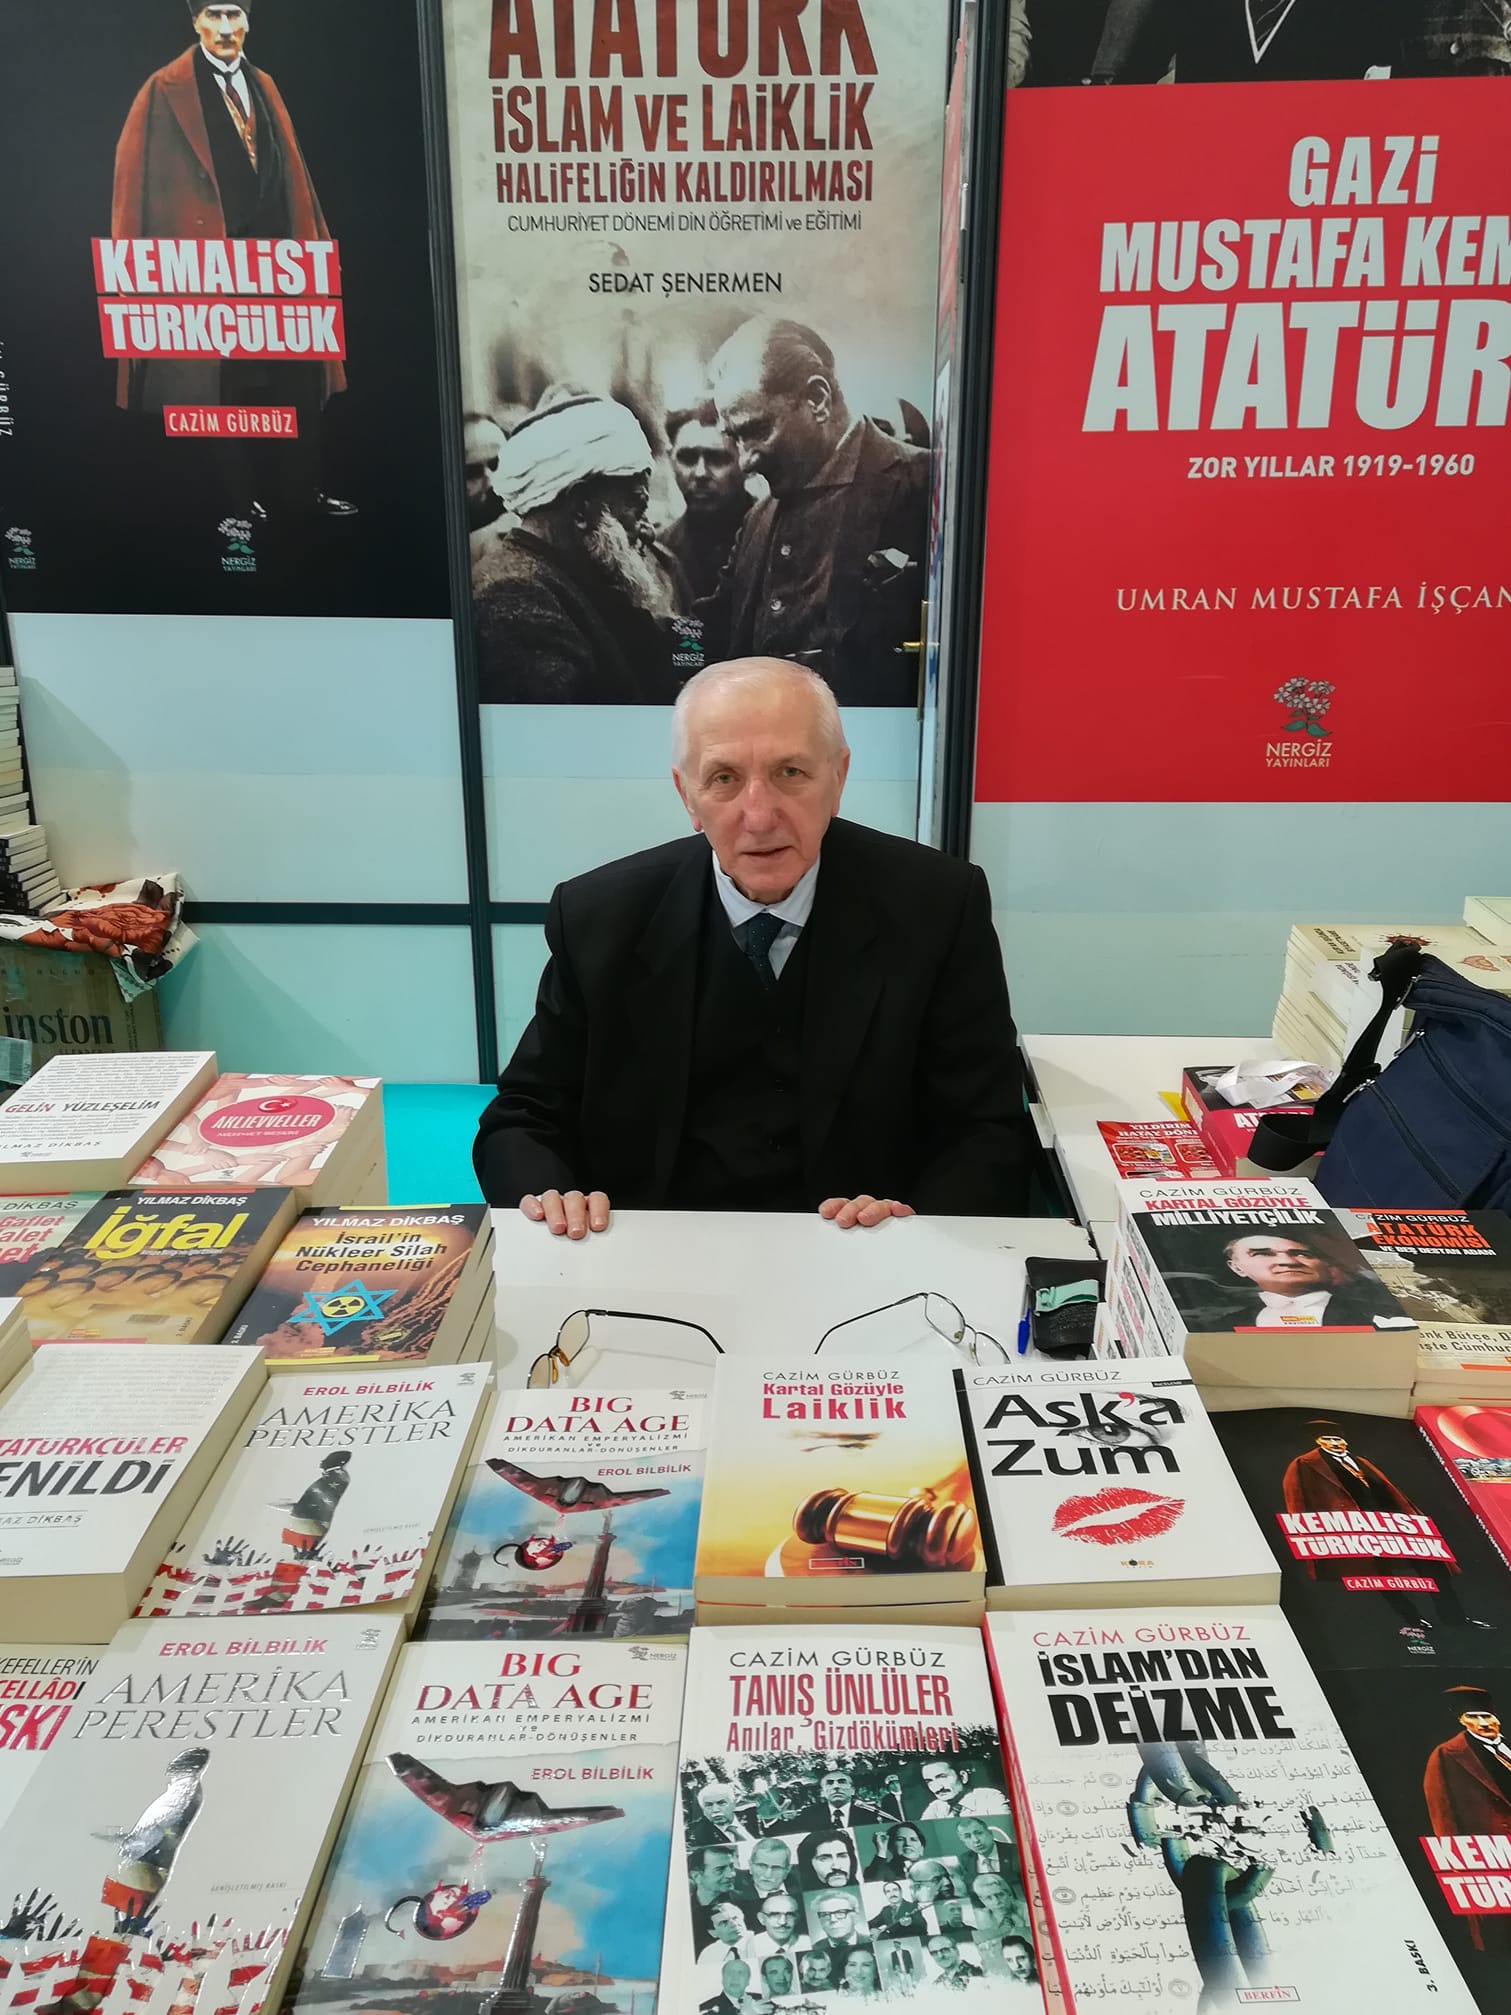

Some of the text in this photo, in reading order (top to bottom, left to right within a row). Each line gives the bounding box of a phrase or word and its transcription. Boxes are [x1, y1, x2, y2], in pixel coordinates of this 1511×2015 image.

[635, 94, 688, 152] VE
[675, 159, 873, 203] KALDIRILMASI
[508, 210, 862, 233] CUMHURİYET DÖNEMİ DİN ÖĞRETİMİ ve EĞİTİMİ
[1099, 217, 1386, 292] MUSTAFA
[588, 272, 782, 298] SEDAT ŞENERMEN
[104, 303, 341, 357] TÜRKÇÜLÜK
[1082, 298, 1511, 432] ATATÜR
[169, 409, 293, 433] CAZİM GÜRBÜZ
[1188, 453, 1475, 480] ZOR YILLAR 1919-1960
[1116, 587, 1237, 612] UMRAN
[1250, 586, 1403, 611] MUSTAFA
[1265, 738, 1333, 757] NERGİZ
[1266, 757, 1331, 768] YAYINLARI
[137, 1196, 190, 1205] YILMAZ
[1139, 1185, 1303, 1198] CAZİM GÜRBÜZ
[1144, 1197, 1313, 1211] KARTAL GÖZÜYLE
[312, 1214, 465, 1227] YILMAZ DİKBAŞ
[1366, 1222, 1481, 1237] ATATÜRK
[83, 1206, 250, 1260] İğfal
[1371, 1234, 1491, 1249] EKONOMİSİ
[0, 1243, 39, 1264] et
[295, 1243, 448, 1258] Nükleer Silah
[295, 1258, 433, 1275] Cephaneliği
[763, 1370, 900, 1381] CAZİM GÜRBÜZ
[972, 1370, 1122, 1386] CAZİM GÜRBÜZ
[303, 1381, 435, 1397] EROL BİLBİLİK
[763, 1382, 904, 1397] Kartal Gözüyle
[259, 1399, 457, 1427] AMERİKA
[570, 1396, 633, 1413] BIG
[763, 1397, 907, 1420] Laiklik
[244, 1421, 452, 1448] PERESTLER
[504, 1414, 690, 1433] DATA AGE
[986, 1438, 1181, 1477] Zum
[597, 1467, 633, 1477] EROL
[1290, 1536, 1452, 1559] TÜRKÇÜLÜK
[1387, 1577, 1435, 1590] GÜRBÜZ
[1032, 1624, 1251, 1648] CAZİM GÜRBÜZ
[159, 1641, 219, 1657] EROL
[730, 1648, 946, 1668] CAZİM GÜRBÜZ
[498, 1652, 581, 1677] BIG
[96, 1666, 352, 1705] AMERİKA
[415, 1683, 653, 1711] DATA AGE
[729, 1667, 953, 1727] TANIŞ ÜNLÜLER
[0, 1703, 73, 1751] SKI
[71, 1707, 344, 1741] PERESTLER
[814, 1720, 959, 1753] Gizdökümleri
[530, 1768, 574, 1780] EROL
[1403, 1939, 1431, 1976] BASKI
